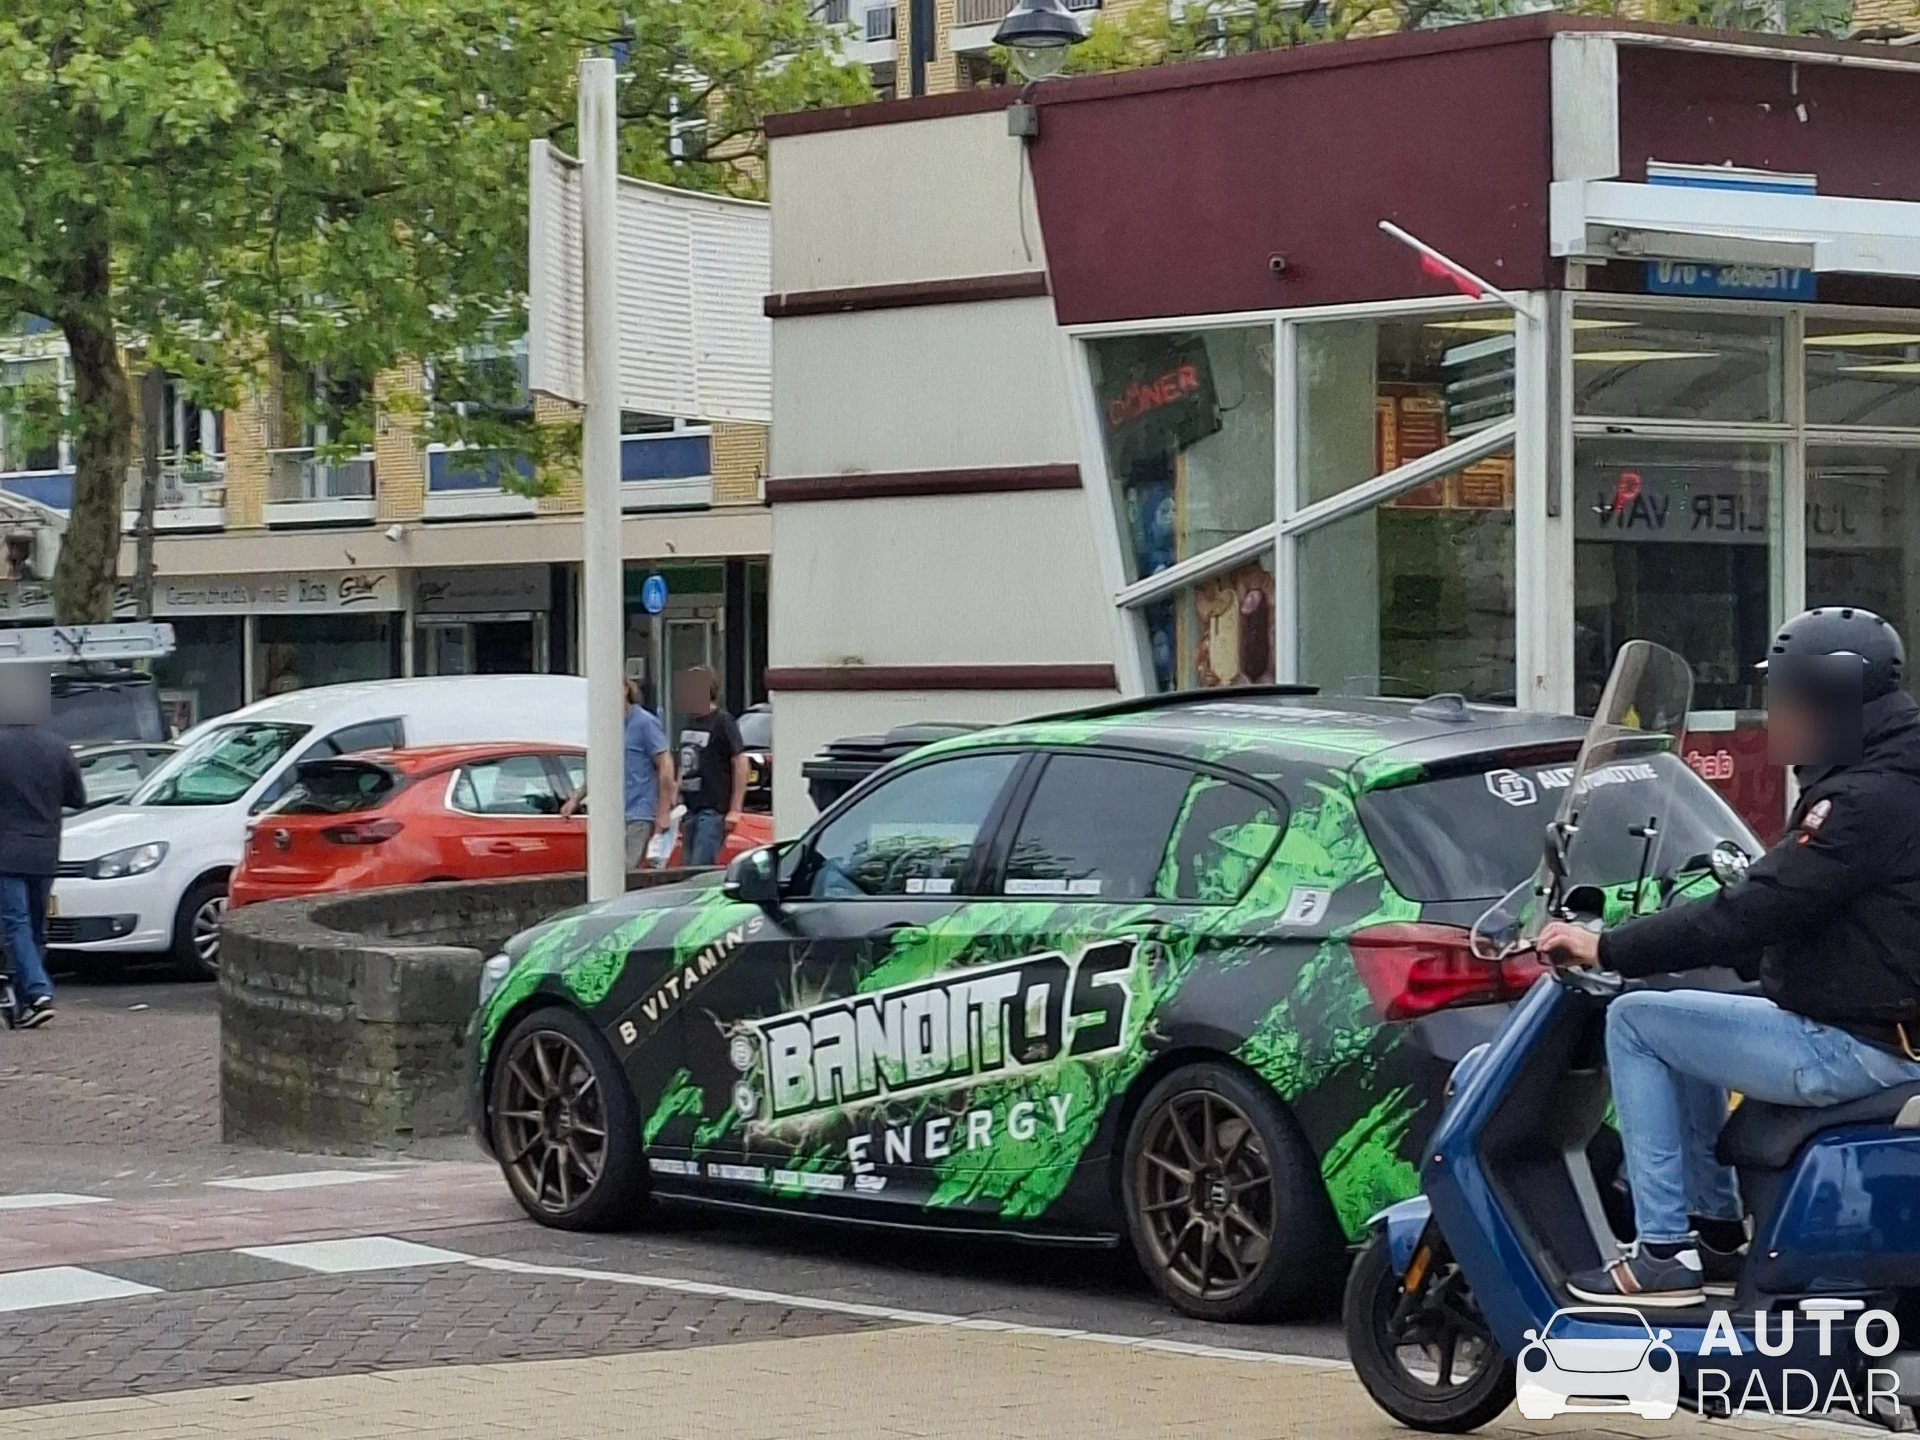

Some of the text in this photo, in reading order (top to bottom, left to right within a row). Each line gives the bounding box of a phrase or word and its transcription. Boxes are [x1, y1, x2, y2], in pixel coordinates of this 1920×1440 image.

[1537, 763, 1658, 795] AUTOMOTIVE
[619, 914, 765, 1045] B VITAMINS
[760, 937, 1138, 1120] BANDITOS
[847, 1093, 1074, 1175] ENERGY
